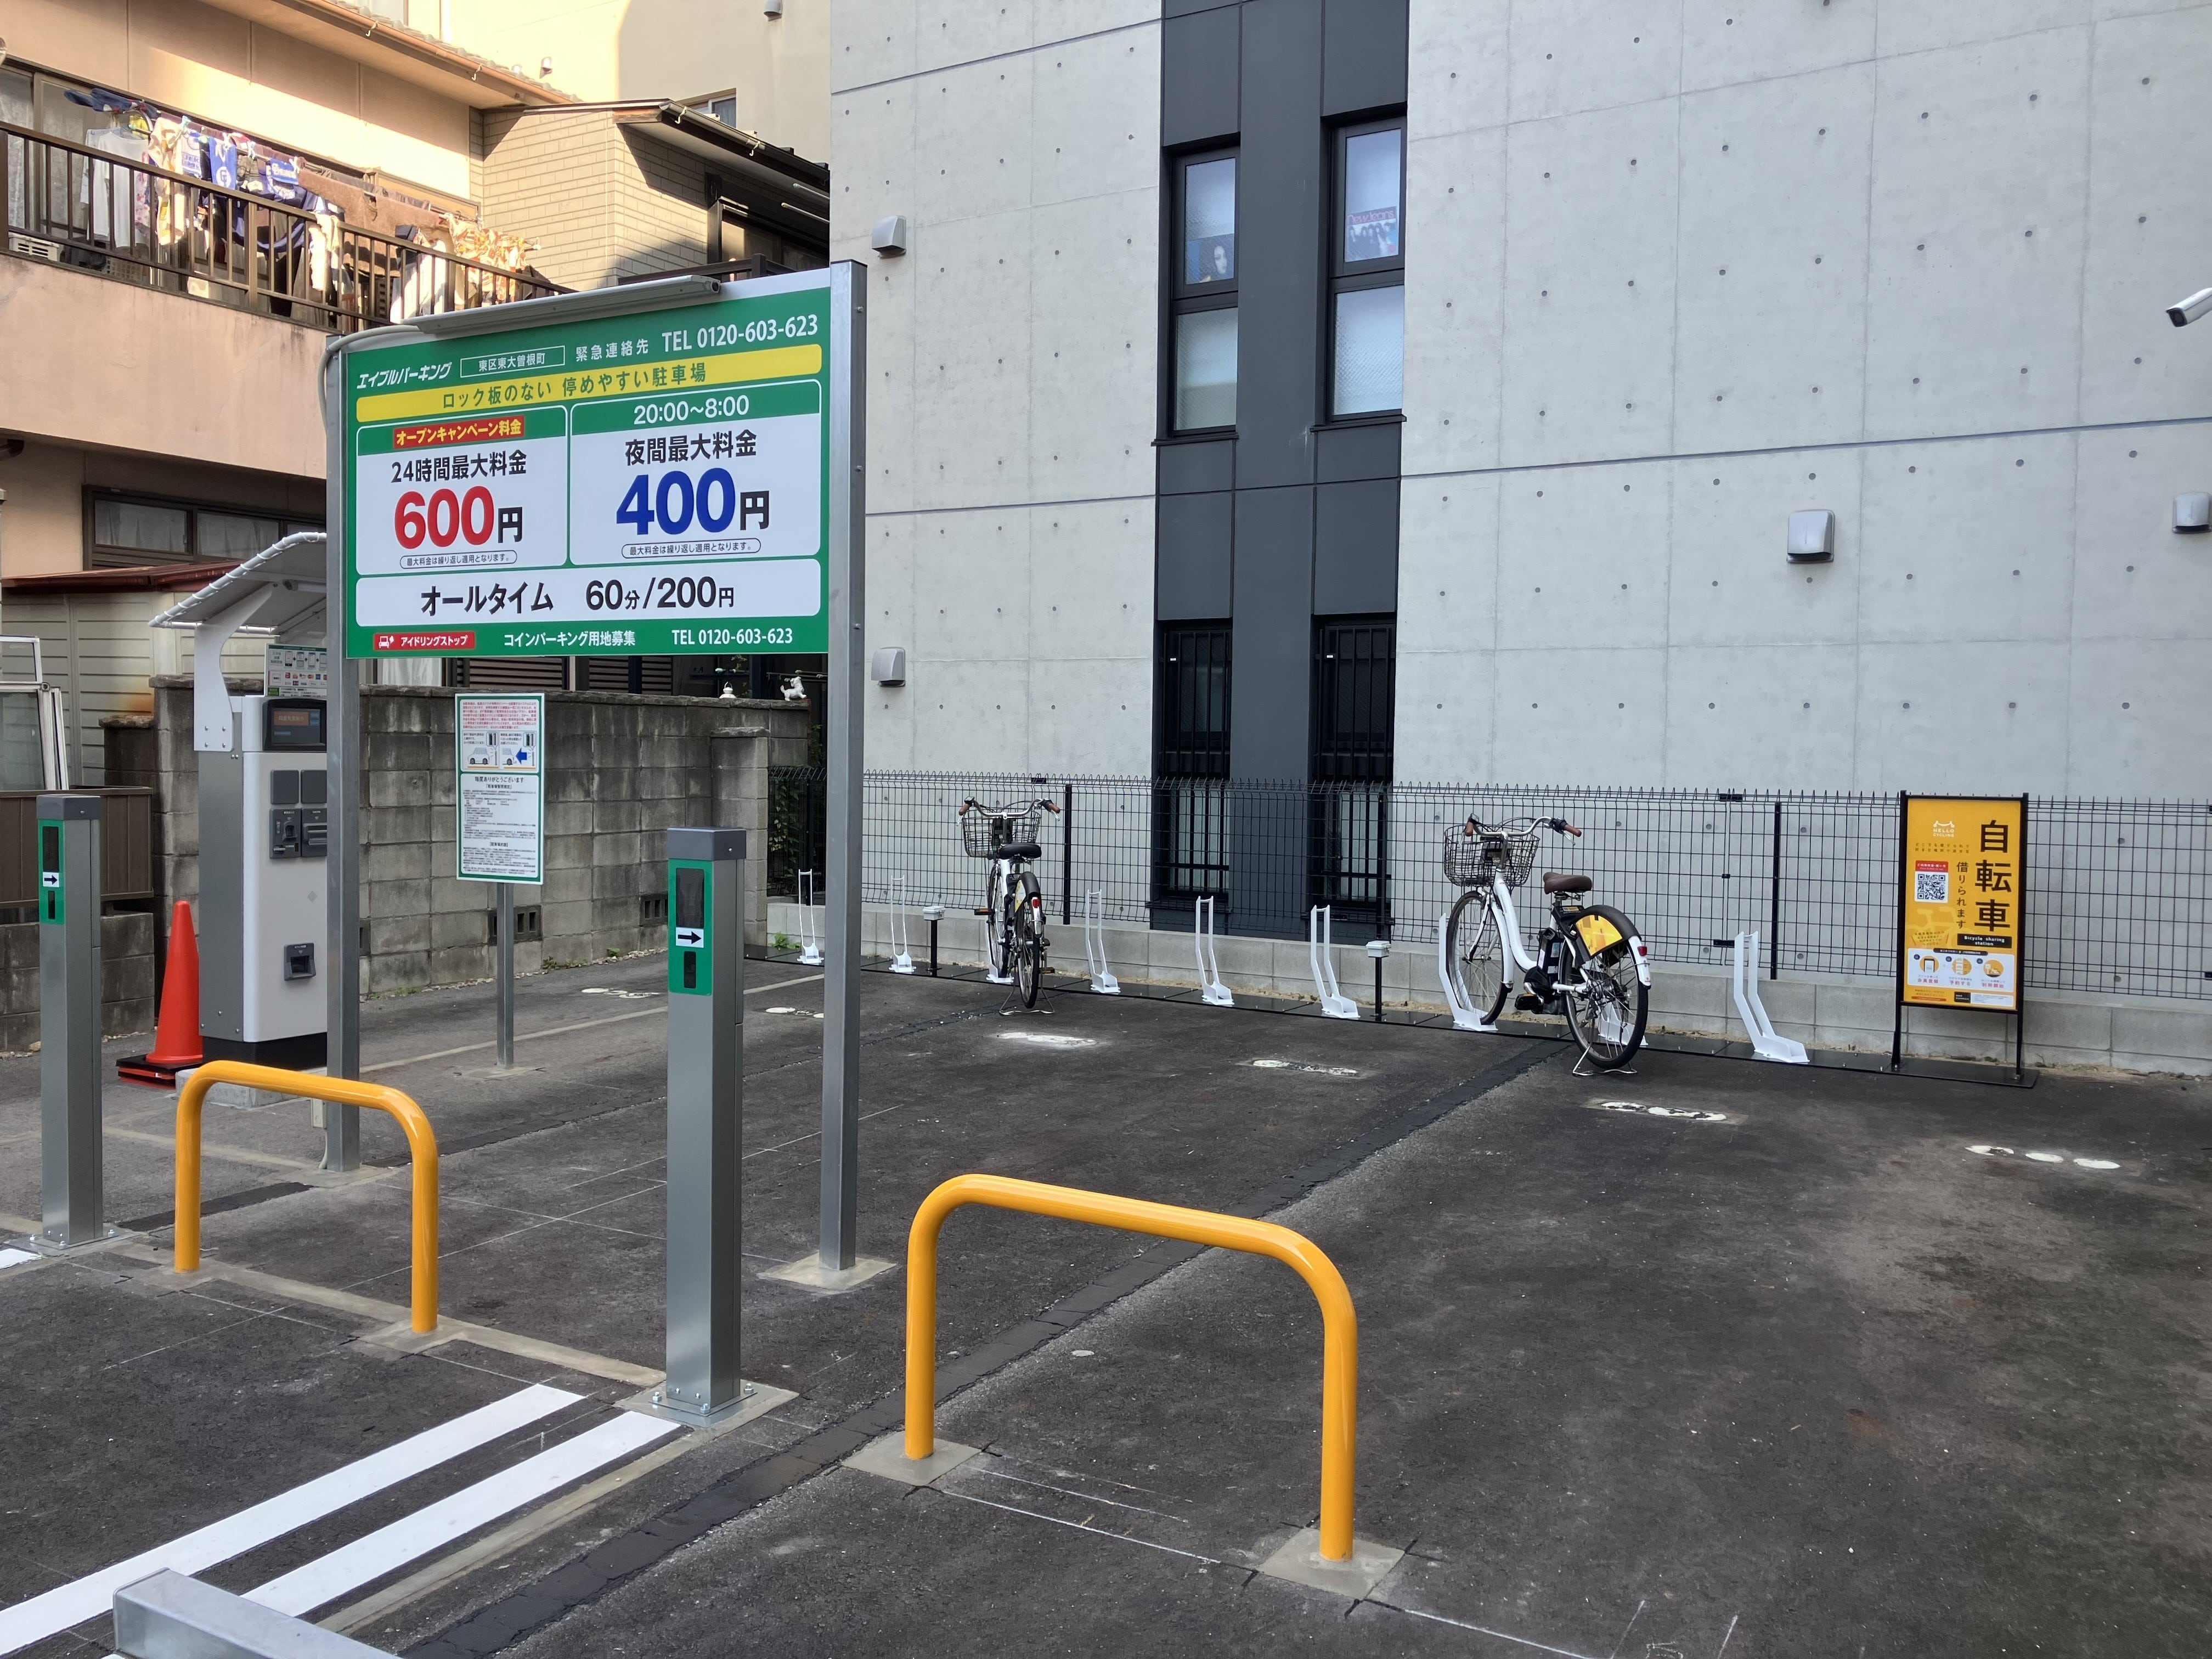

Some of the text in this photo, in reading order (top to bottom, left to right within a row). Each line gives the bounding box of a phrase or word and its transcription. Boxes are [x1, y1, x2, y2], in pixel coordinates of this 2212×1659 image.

[575, 314, 819, 360] 緊急連絡先 TEL 0120-603-623
[357, 362, 452, 390] エイブルパーキング
[478, 353, 545, 373] 東区東大曽根町
[442, 363, 707, 410] ロック板のない 停めやすい駐車場
[396, 419, 522, 447] オープンキャンペーン料金
[625, 430, 757, 466] 夜間最大料金
[391, 449, 527, 483] 24時間最大料金
[394, 486, 523, 549] 600円
[617, 468, 770, 535] 400円
[406, 554, 510, 567] 最大料金は繰り返し適用となります。
[629, 542, 754, 557] 最大料金は繰り返し適用となります。
[421, 576, 735, 616] オールタイム 60分/200円
[400, 635, 468, 647] アイドリングストップ
[504, 628, 793, 648] コインパーキング用地募集 TEL 0120-603-623
[1974, 820, 2012, 932] 自転車
[1956, 861, 1968, 929] 借りられます
